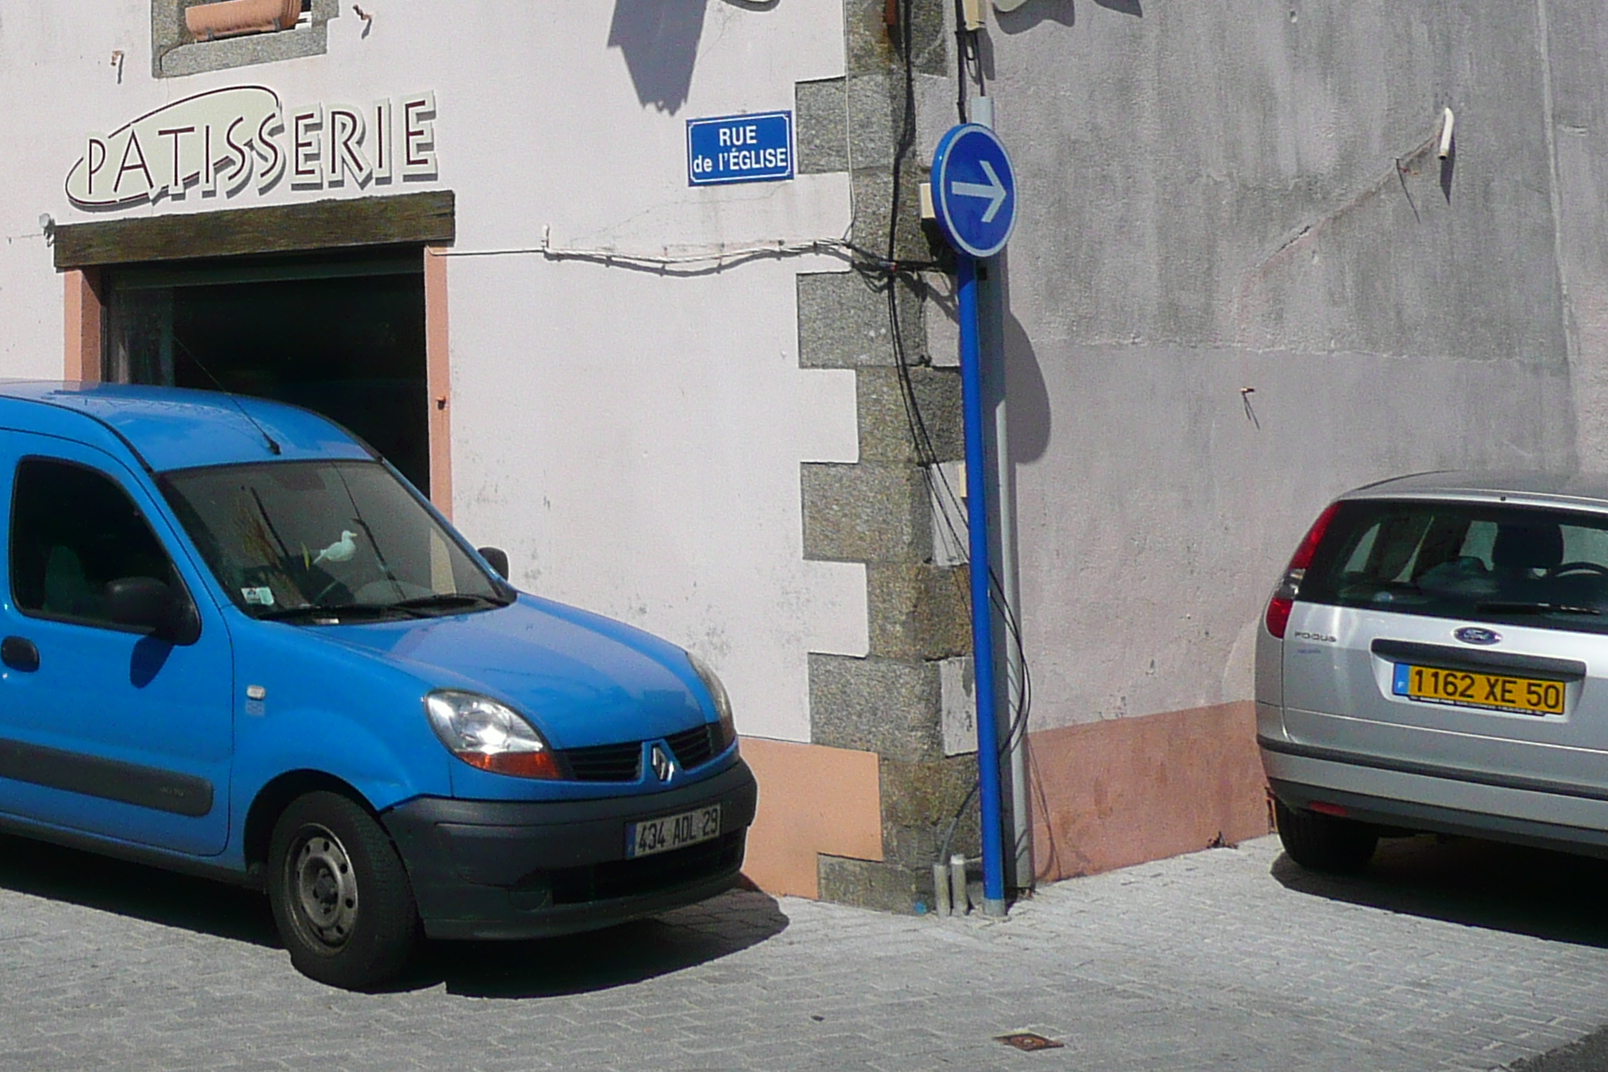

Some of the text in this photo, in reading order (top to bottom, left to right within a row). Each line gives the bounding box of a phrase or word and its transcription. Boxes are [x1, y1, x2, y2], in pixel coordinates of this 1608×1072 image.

[85, 91, 437, 200] PATISSERIE
[719, 125, 757, 146] RUE
[693, 147, 787, 173] de l'ÉGLISE
[1414, 669, 1475, 699] 1162
[1484, 676, 1518, 704] XE
[1526, 682, 1560, 710] 50
[639, 822, 666, 852] 434
[673, 814, 696, 845] ADL
